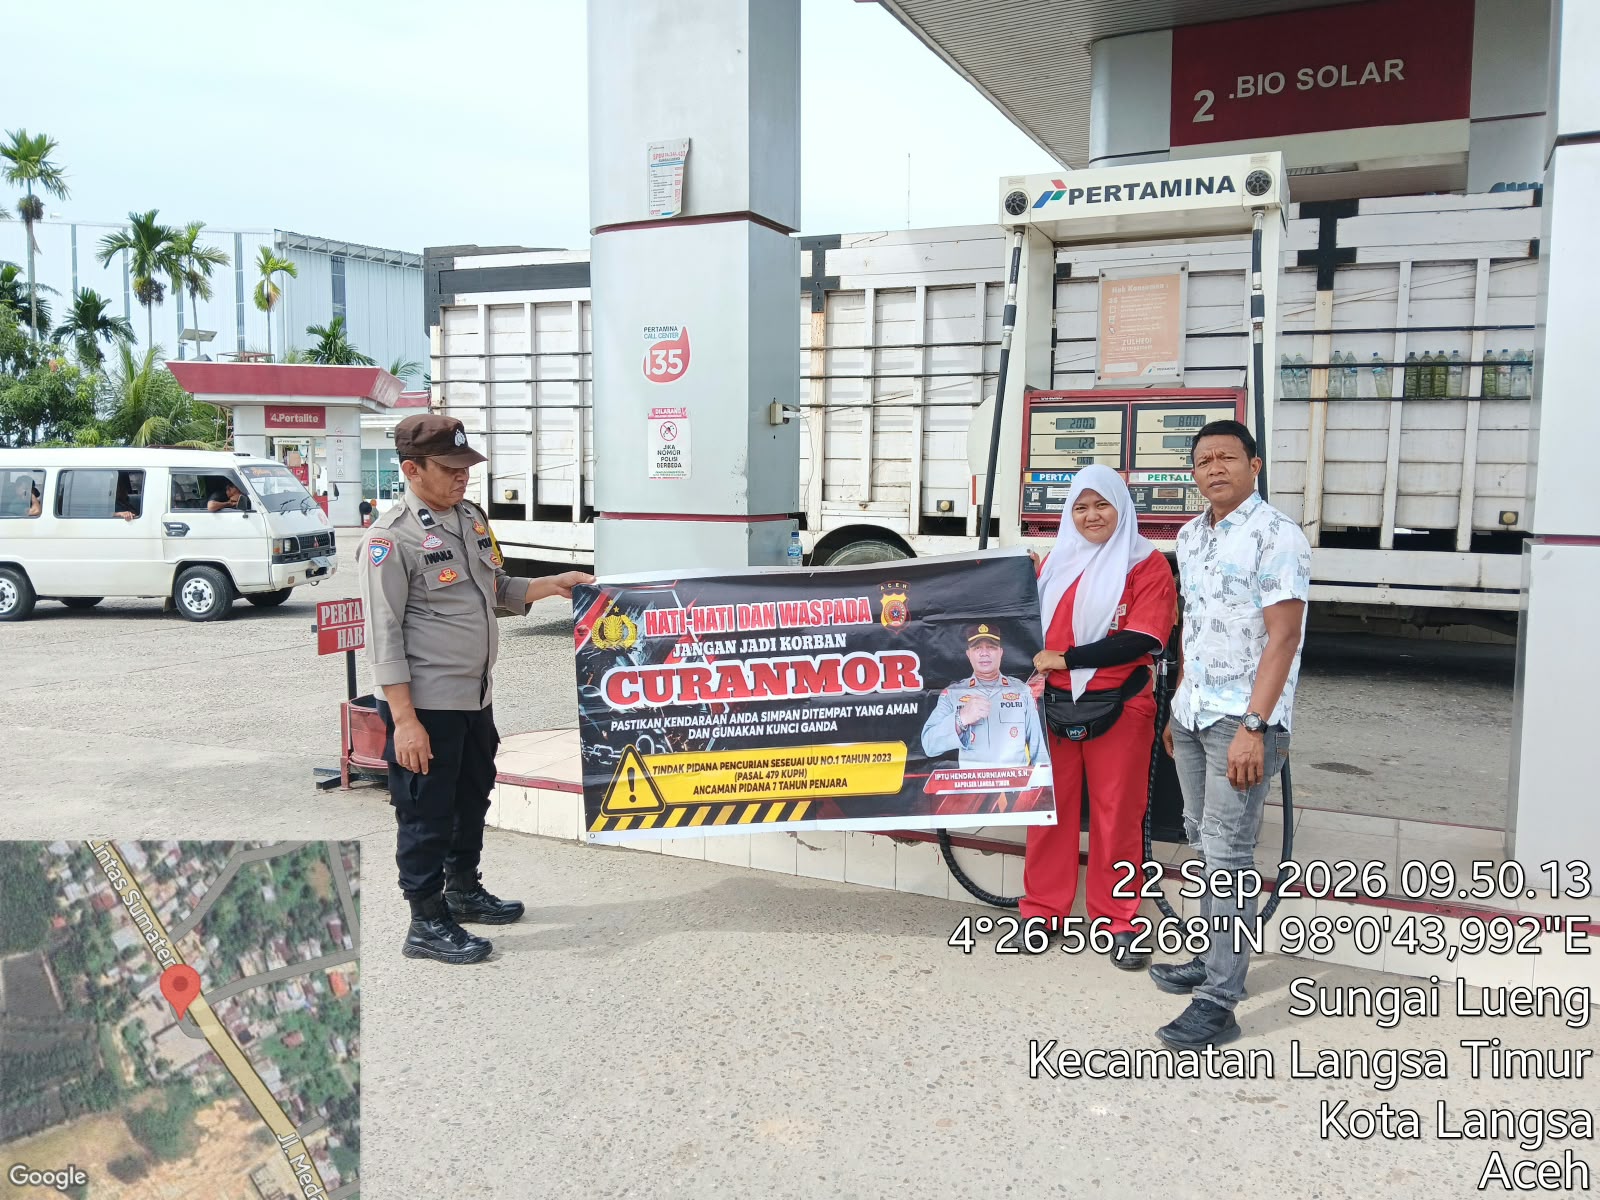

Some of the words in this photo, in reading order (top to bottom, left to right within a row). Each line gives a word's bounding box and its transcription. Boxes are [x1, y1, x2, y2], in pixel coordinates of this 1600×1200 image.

[1192, 89, 1215, 123] 2
[1296, 58, 1405, 90] SOLAR
[1068, 175, 1236, 206] PERTAMINA
[643, 325, 679, 333] PERTAMINA
[645, 349, 683, 375] 135
[271, 413, 319, 423] 4.Pertalite
[880, 582, 908, 591] ACEH
[321, 601, 364, 626] PERTA
[645, 606, 734, 636] HATI-HATI
[738, 601, 776, 631] DAN
[778, 597, 873, 628] WASPADA
[337, 626, 365, 650] HAB
[673, 639, 736, 657] JANGAN
[740, 637, 776, 654] JADI
[780, 633, 847, 651] KORBAN
[603, 651, 922, 708] CURANMOR
[1000, 701, 1023, 709] POLRI
[611, 718, 661, 732] PASTIKAN
[664, 713, 728, 728] KENDARAAN
[729, 712, 758, 724] ANDA
[761, 709, 800, 722] SIMPAN
[802, 706, 852, 720] DITEMPAT
[854, 704, 884, 717] YANG
[885, 702, 918, 716] AMAN
[688, 728, 712, 740] DAN
[713, 725, 763, 738] GUNAKAN
[766, 722, 799, 735] KUNCI
[801, 720, 838, 732] GANDA
[653, 763, 685, 775] TINDAK
[686, 762, 717, 773] PIDANA
[720, 759, 768, 771] PENCURIAN
[771, 757, 805, 768] SESEUAI
[806, 756, 819, 766] UU
[820, 755, 839, 765] NO.1
[841, 754, 871, 764] TAHUN
[872, 753, 892, 763] 2023
[735, 771, 763, 783] (PASAL
[765, 770, 780, 779] 479
[781, 768, 808, 779] KUPH)
[693, 784, 737, 796] ANCAMAN
[739, 782, 771, 793] PIDANA
[772, 781, 778, 791] 7
[779, 780, 808, 791] TAHUN
[809, 778, 848, 789] PENJARA
[934, 773, 950, 781] IPTU
[951, 772, 976, 781] HENDRA
